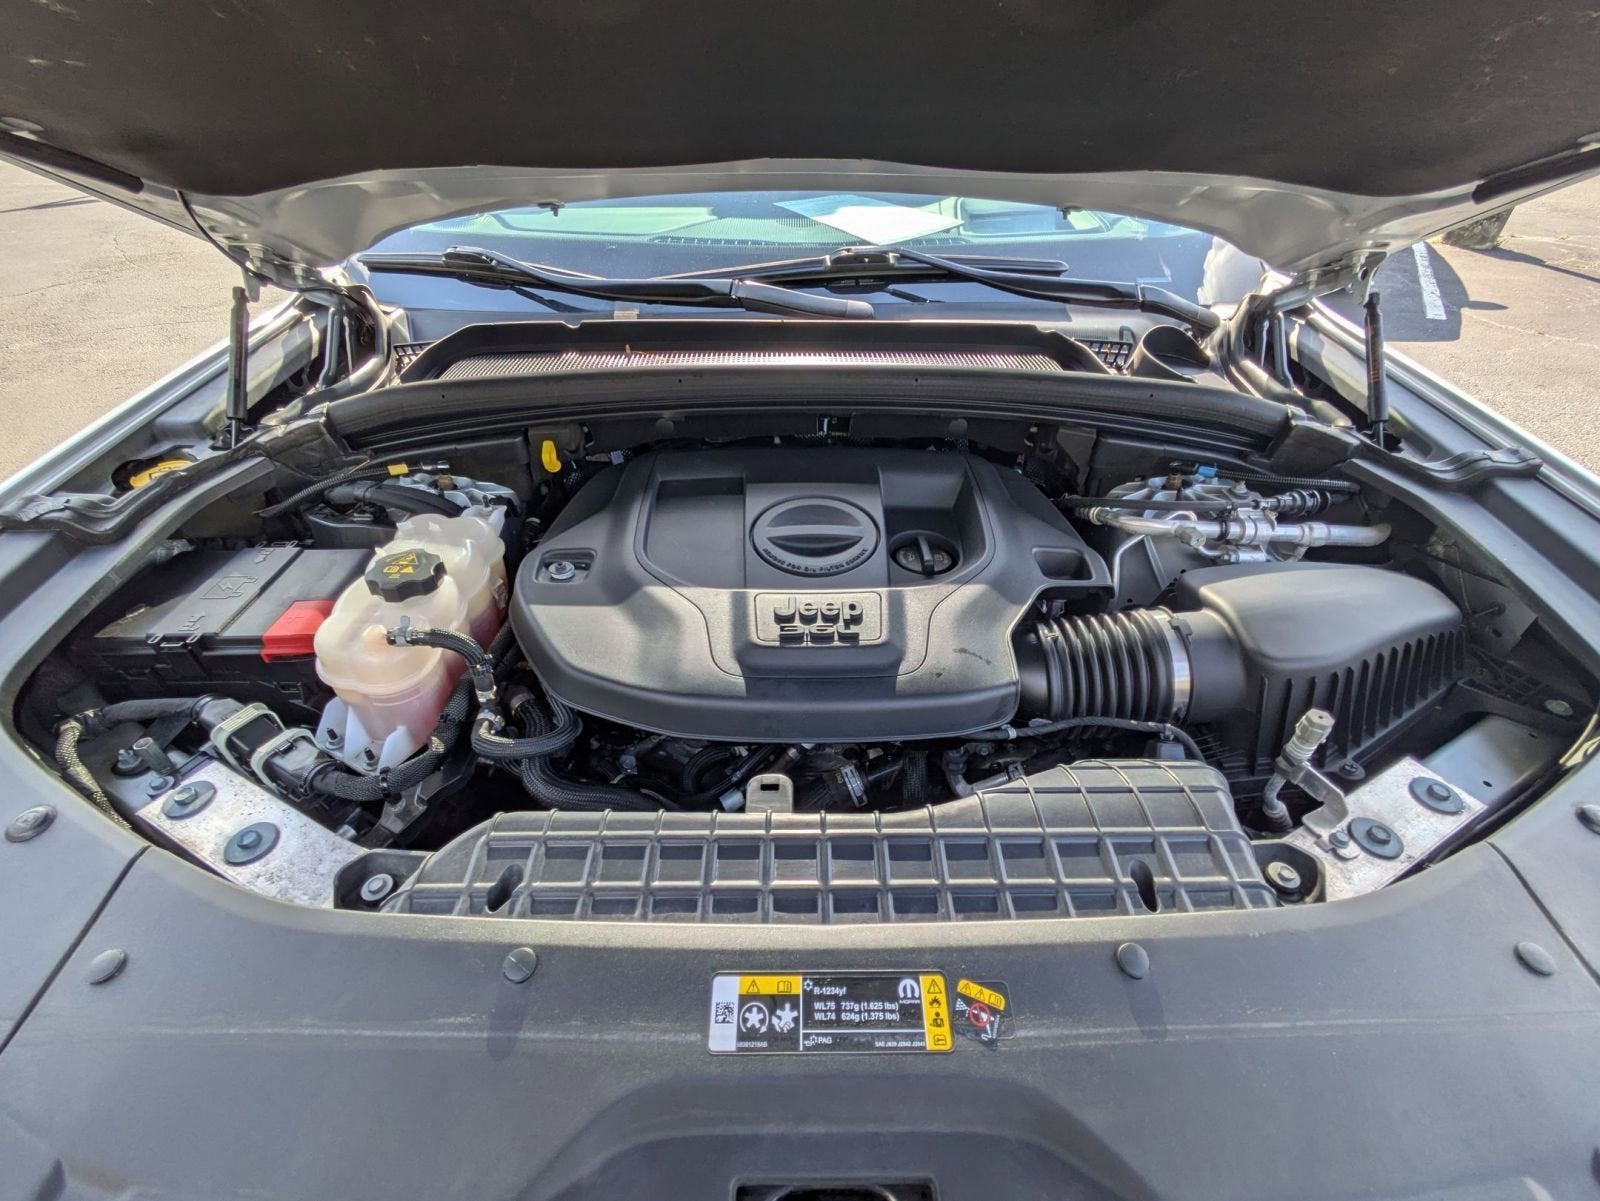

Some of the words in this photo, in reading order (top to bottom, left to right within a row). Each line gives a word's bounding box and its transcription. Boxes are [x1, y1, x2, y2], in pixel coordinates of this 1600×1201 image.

[774, 596, 863, 625] Jeep
[813, 986, 847, 997] R-1234yf
[814, 1001, 836, 1010] WL75
[840, 1001, 860, 1012] 737g
[860, 1001, 883, 1012] (1.625
[884, 1001, 899, 1012] lbs)
[814, 1011, 836, 1020] WL74
[841, 1011, 860, 1022] 624g
[861, 1011, 884, 1022] (1.375
[885, 1011, 900, 1022] lbs)
[818, 1036, 833, 1044] PAG
